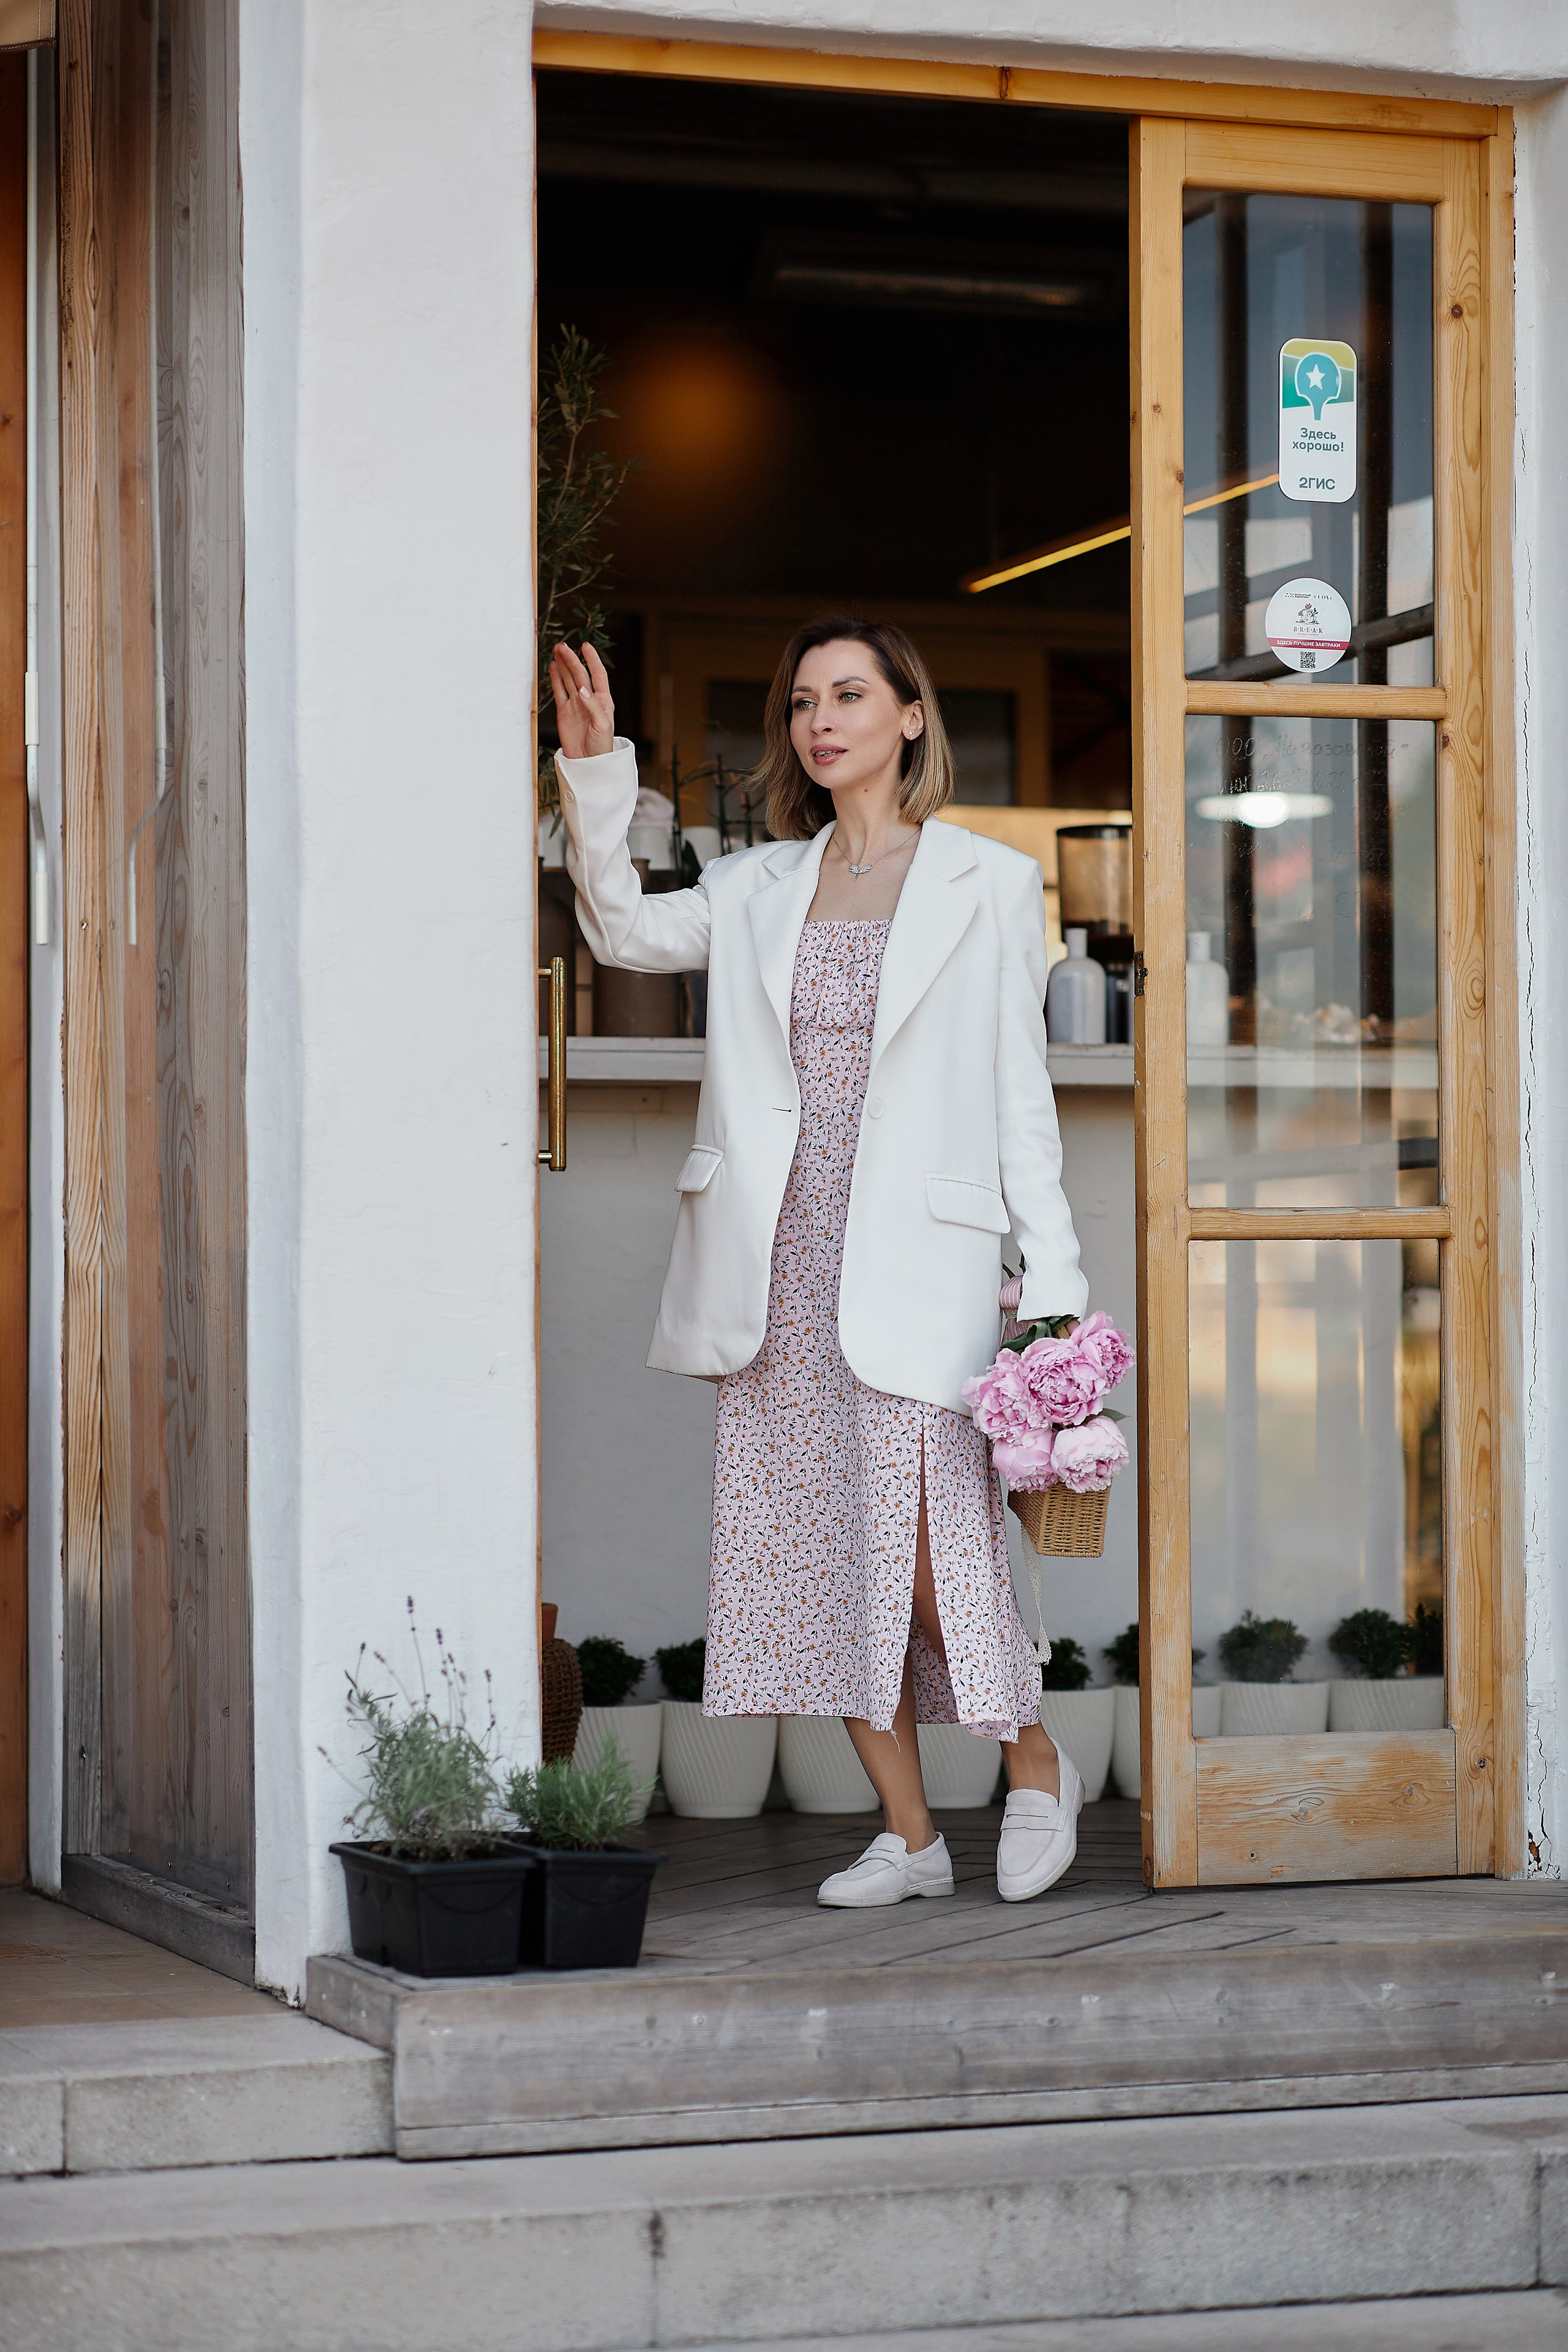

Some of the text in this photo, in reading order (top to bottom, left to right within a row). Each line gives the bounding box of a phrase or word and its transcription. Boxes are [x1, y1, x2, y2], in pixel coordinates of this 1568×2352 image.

[1300, 428, 1336, 440] Здесь
[1292, 441, 1344, 453] хорошо!
[1299, 477, 1336, 490] 2ГИС
